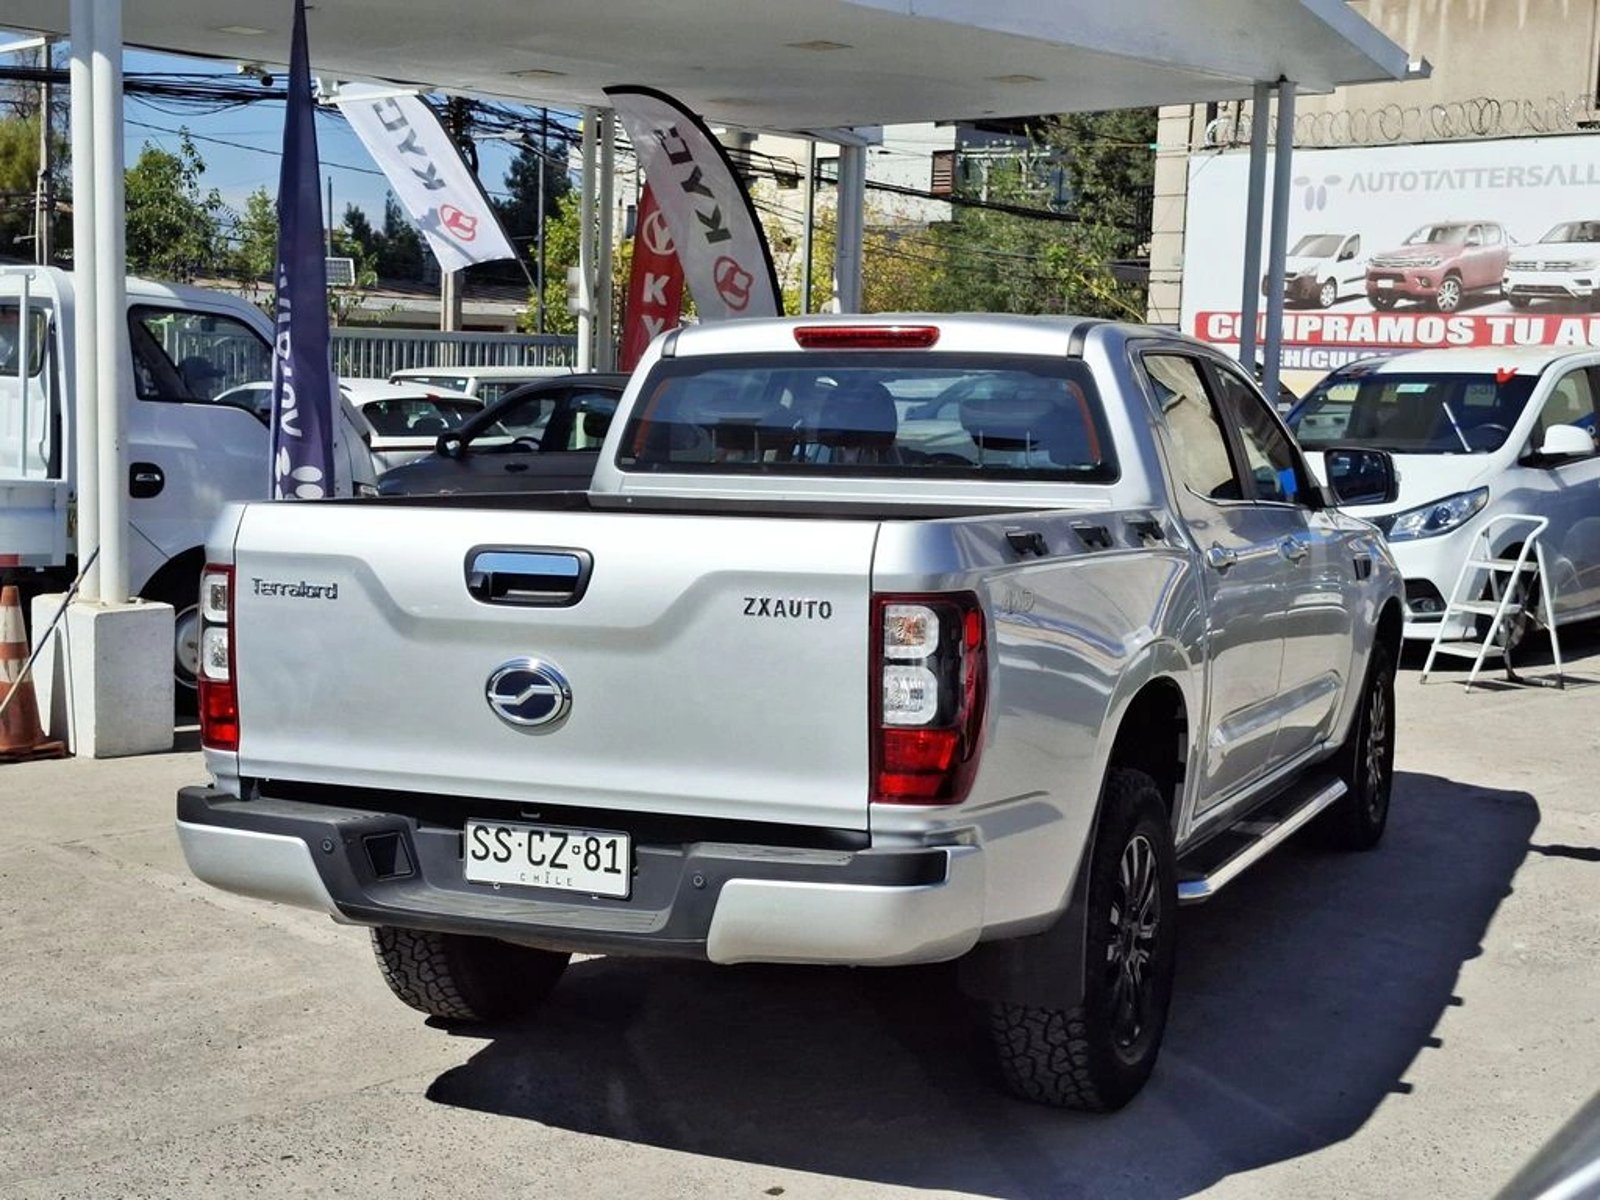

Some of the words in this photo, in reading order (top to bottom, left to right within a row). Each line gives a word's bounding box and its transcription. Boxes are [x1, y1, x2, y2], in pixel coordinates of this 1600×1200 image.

[1348, 163, 1600, 194] AUTOTATTERSALL
[1486, 318, 1545, 345] TU
[252, 578, 338, 600] Terralord
[743, 597, 832, 620] ZXAUTO
[520, 871, 573, 887] CHILE
